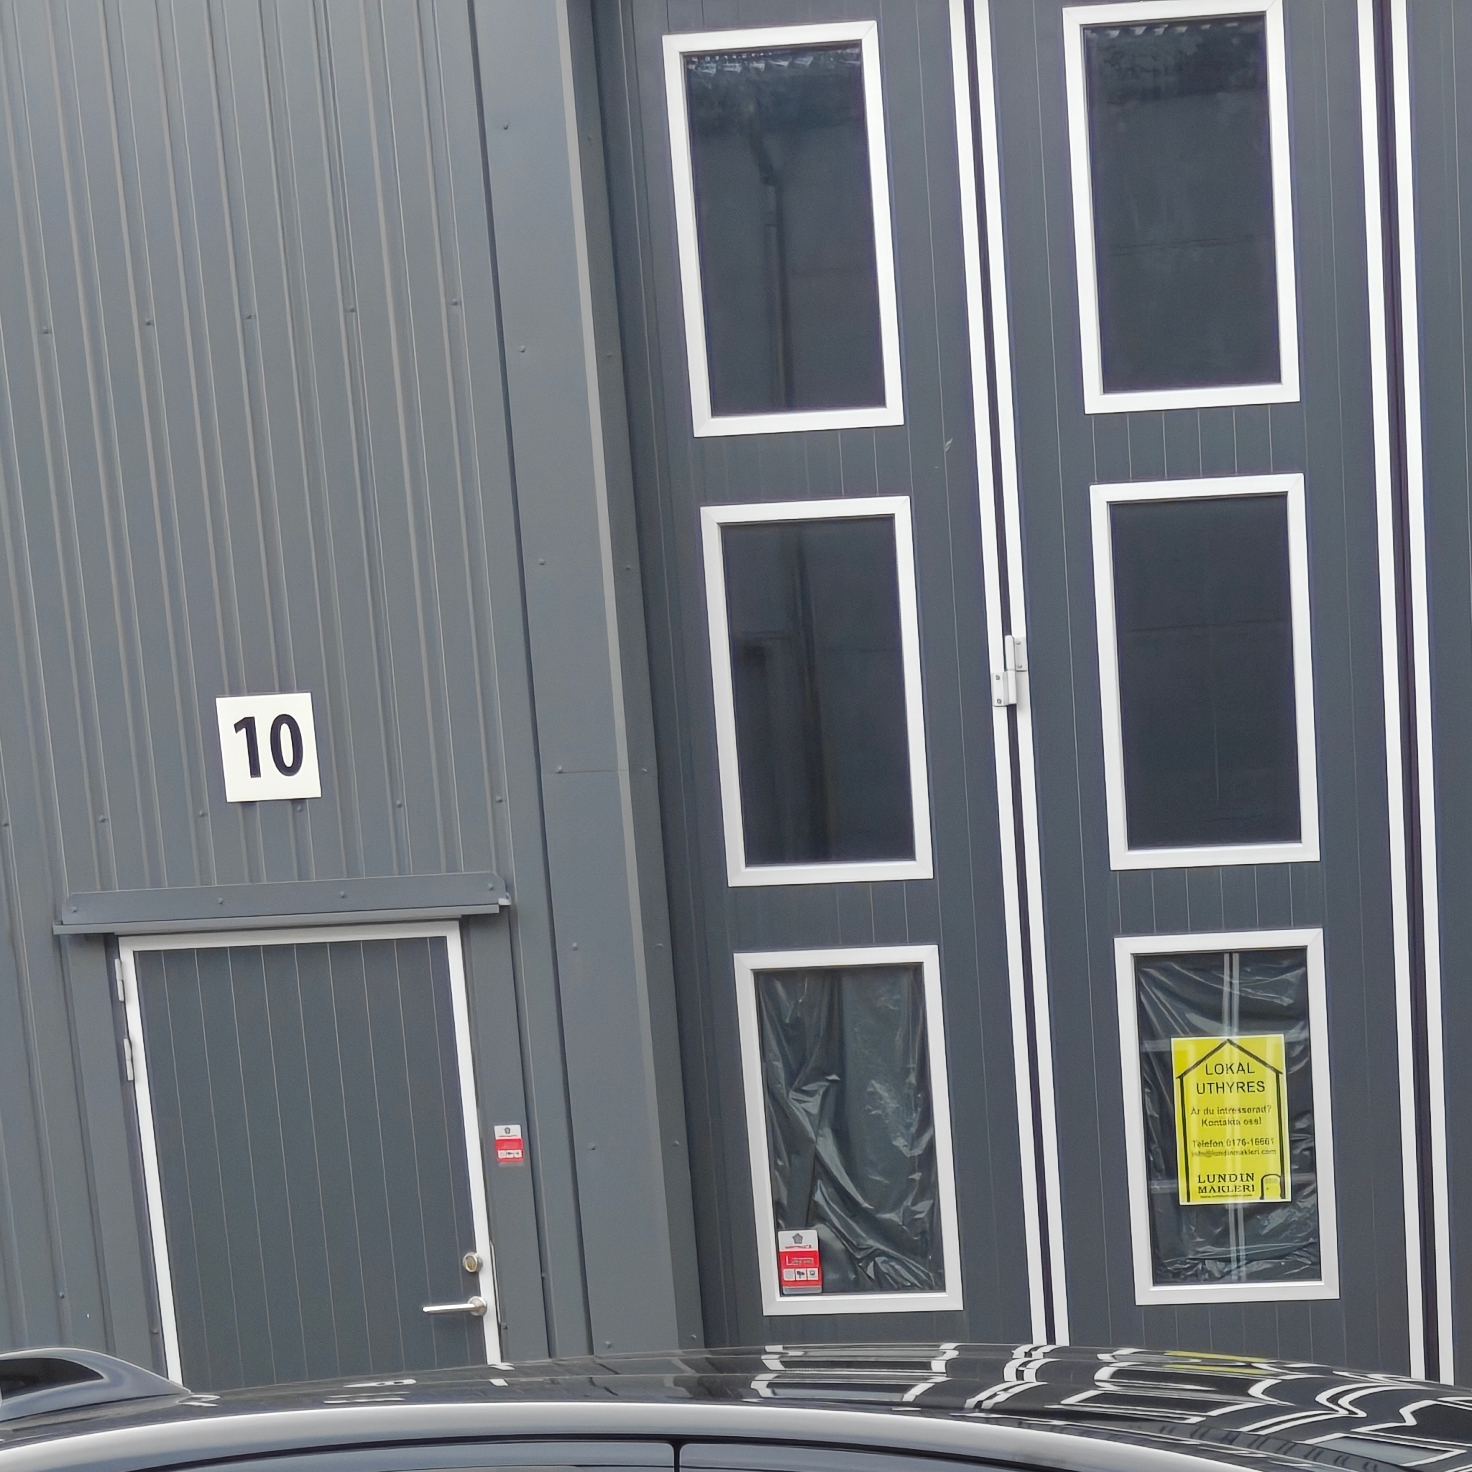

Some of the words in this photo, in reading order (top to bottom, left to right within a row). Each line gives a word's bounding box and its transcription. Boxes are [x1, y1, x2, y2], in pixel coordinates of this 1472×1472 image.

[234, 713, 304, 778] 10
[1205, 1062, 1255, 1076] LOKAL
[1196, 1080, 1265, 1095] UTHYRES
[1193, 1140, 1224, 1148] Telefon
[1197, 1172, 1255, 1183] LUNDIN
